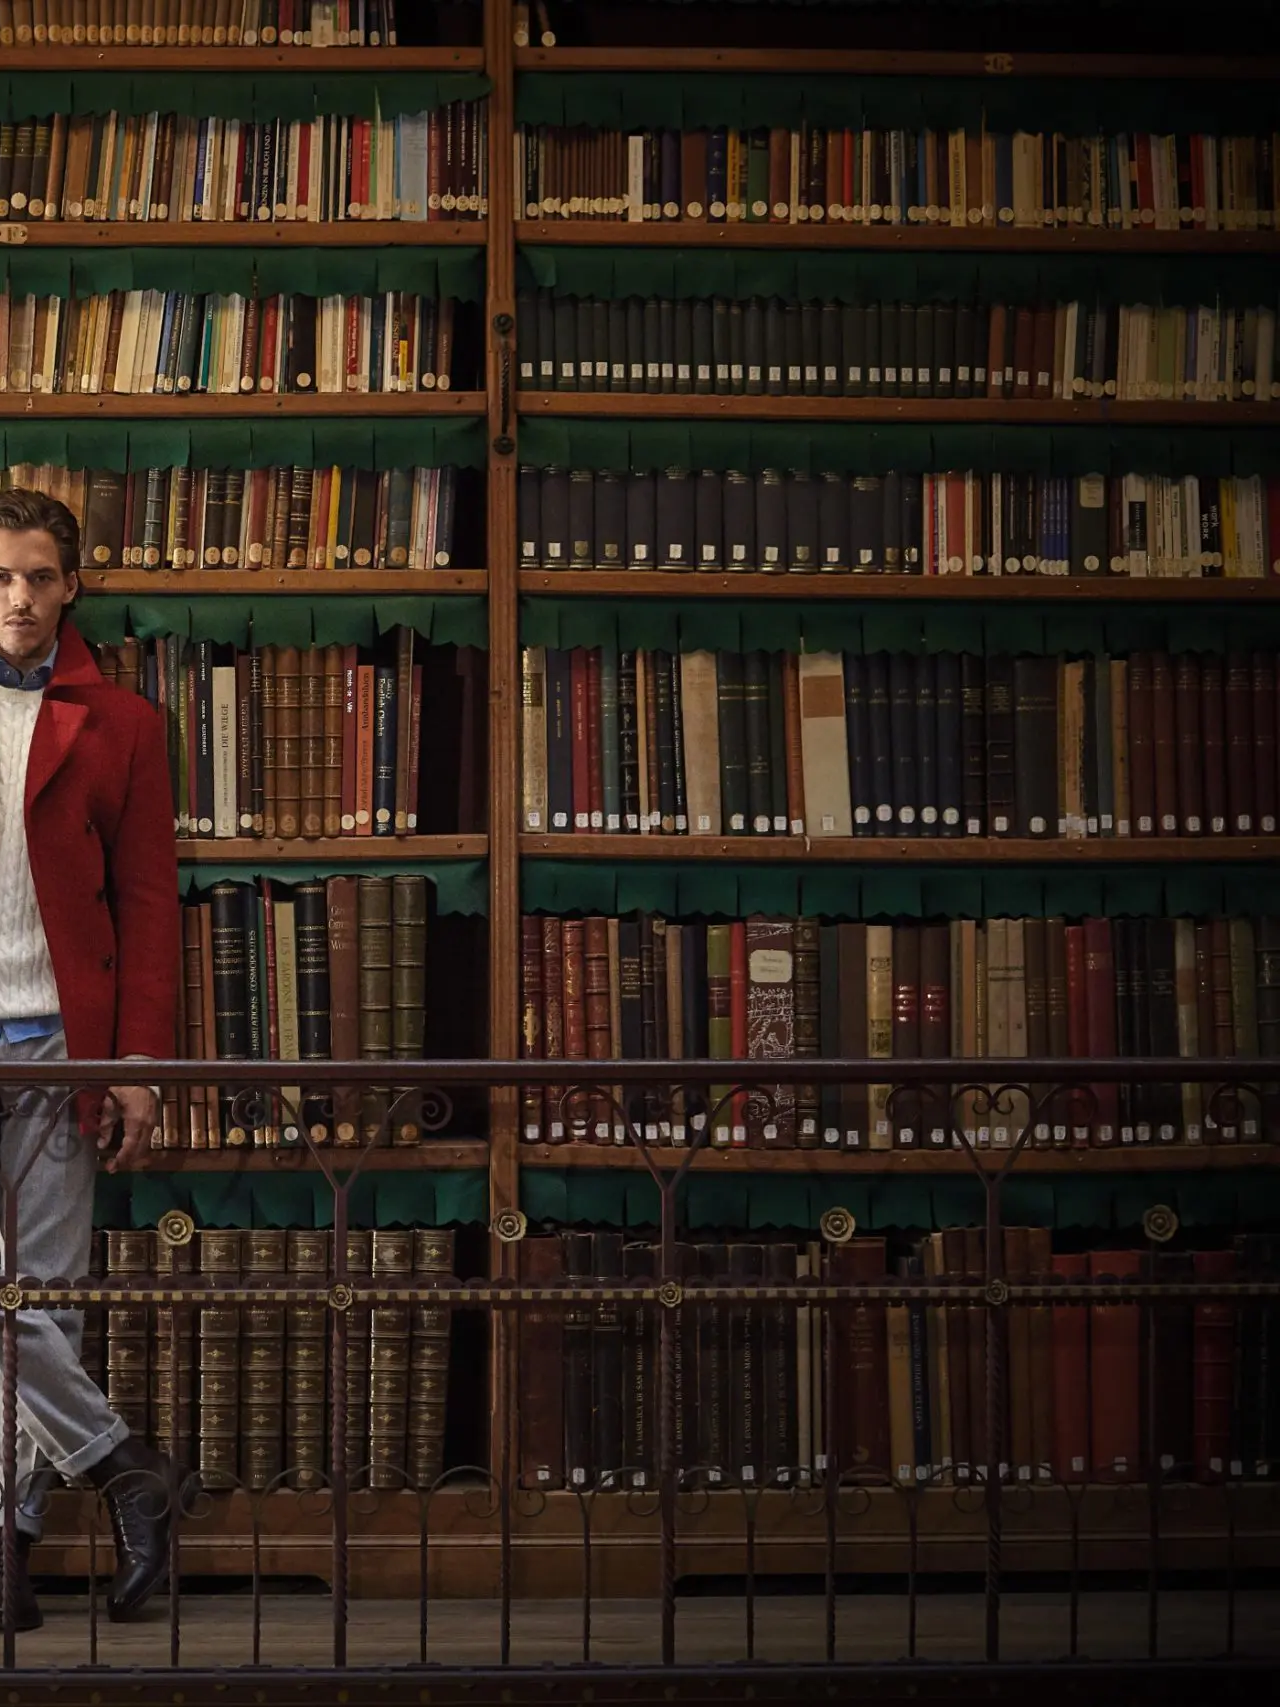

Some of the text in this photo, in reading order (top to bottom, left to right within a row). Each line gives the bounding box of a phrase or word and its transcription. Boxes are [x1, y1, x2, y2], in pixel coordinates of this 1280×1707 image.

[221, 703, 229, 748] DIE WIEGE
[376, 678, 386, 737] English Clocks
[249, 930, 260, 1051] HABITATIONS COSMOPOLITES
[636, 1374, 644, 1390] SAN
